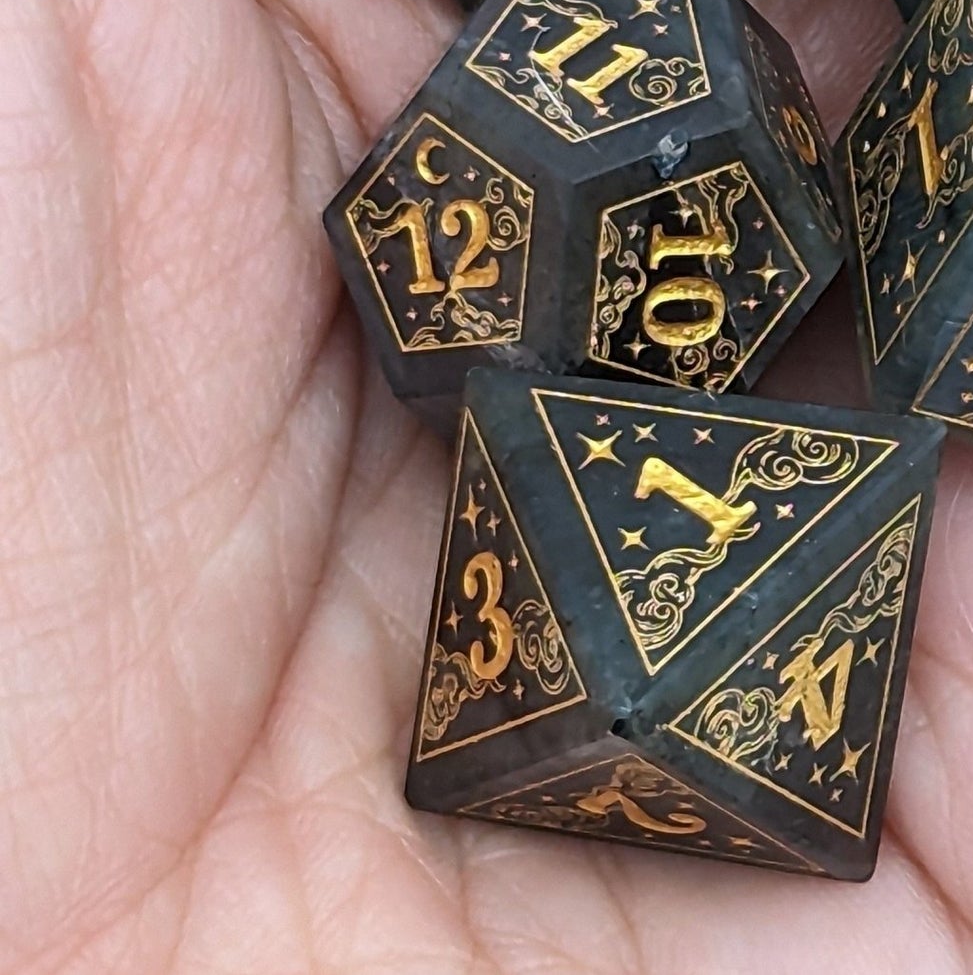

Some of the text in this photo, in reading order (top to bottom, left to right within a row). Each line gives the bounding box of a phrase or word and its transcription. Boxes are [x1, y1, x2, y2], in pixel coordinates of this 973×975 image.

[527, 15, 650, 105] 11
[908, 79, 945, 198] 1
[392, 198, 500, 296] 12
[642, 221, 735, 347] 10
[634, 457, 757, 545] 1
[463, 552, 514, 681] 3
[777, 636, 855, 751] 4
[576, 790, 706, 834] 2
